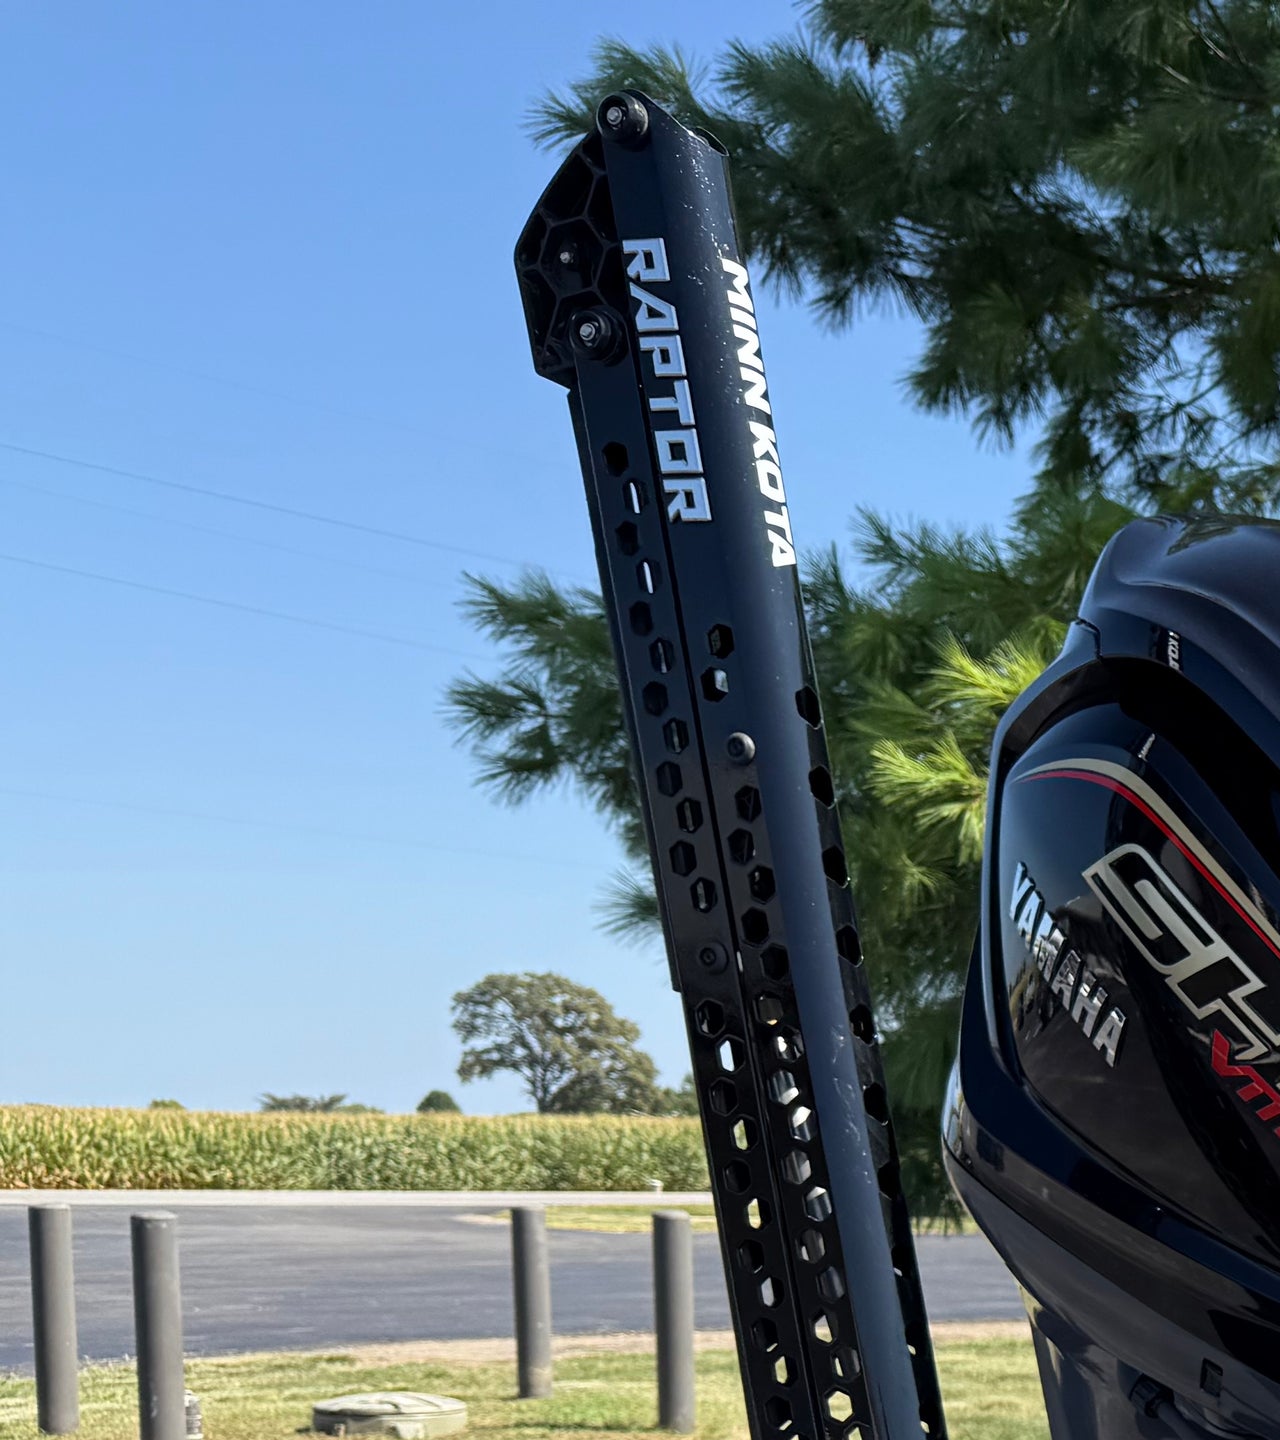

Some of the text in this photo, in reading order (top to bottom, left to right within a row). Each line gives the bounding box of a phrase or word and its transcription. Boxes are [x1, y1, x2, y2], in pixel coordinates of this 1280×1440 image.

[622, 237, 711, 523] RAPTOR
[722, 258, 796, 567] MINN KOTA
[1009, 861, 1127, 1068] YAMAHA
